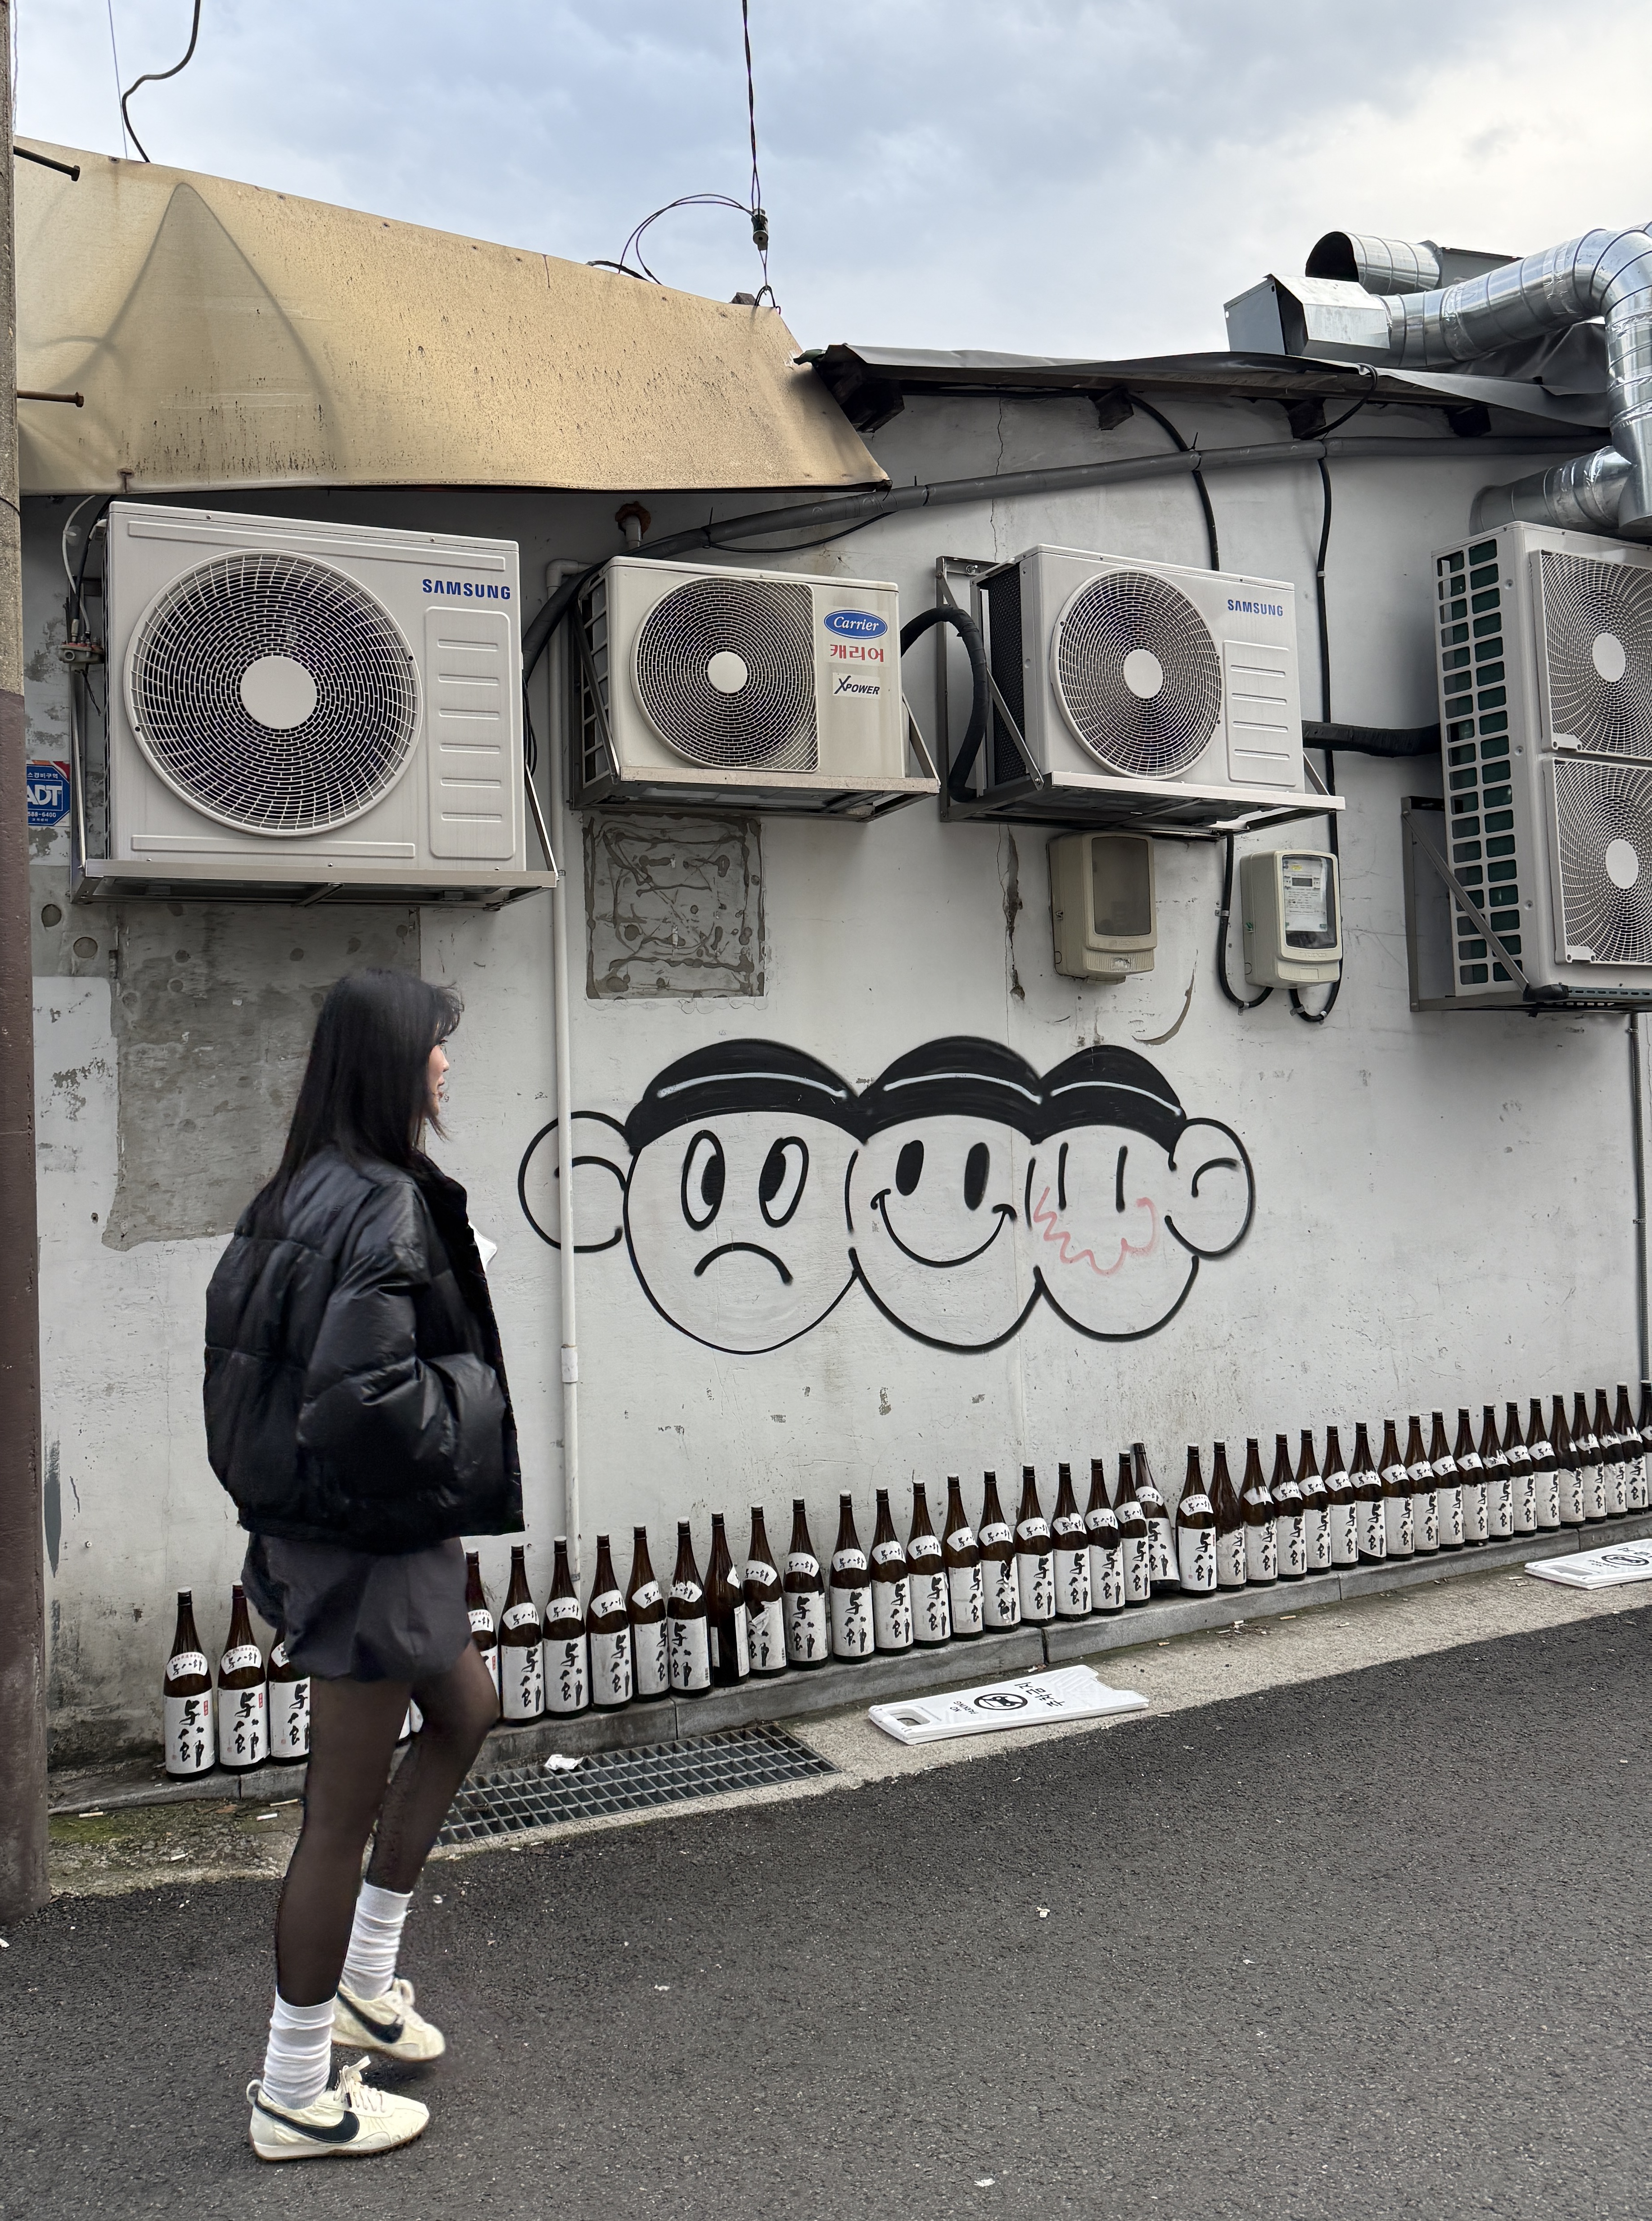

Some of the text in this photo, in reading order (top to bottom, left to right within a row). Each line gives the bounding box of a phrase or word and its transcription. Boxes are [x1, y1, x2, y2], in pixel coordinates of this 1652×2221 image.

[422, 579, 510, 600] SAMSUNG
[1228, 599, 1283, 616] SAMSUNG
[834, 616, 879, 631] Carrier
[830, 644, 884, 663] 캐리어
[27, 784, 62, 806] ADT
[1015, 1682, 1065, 1707] 주차금지
